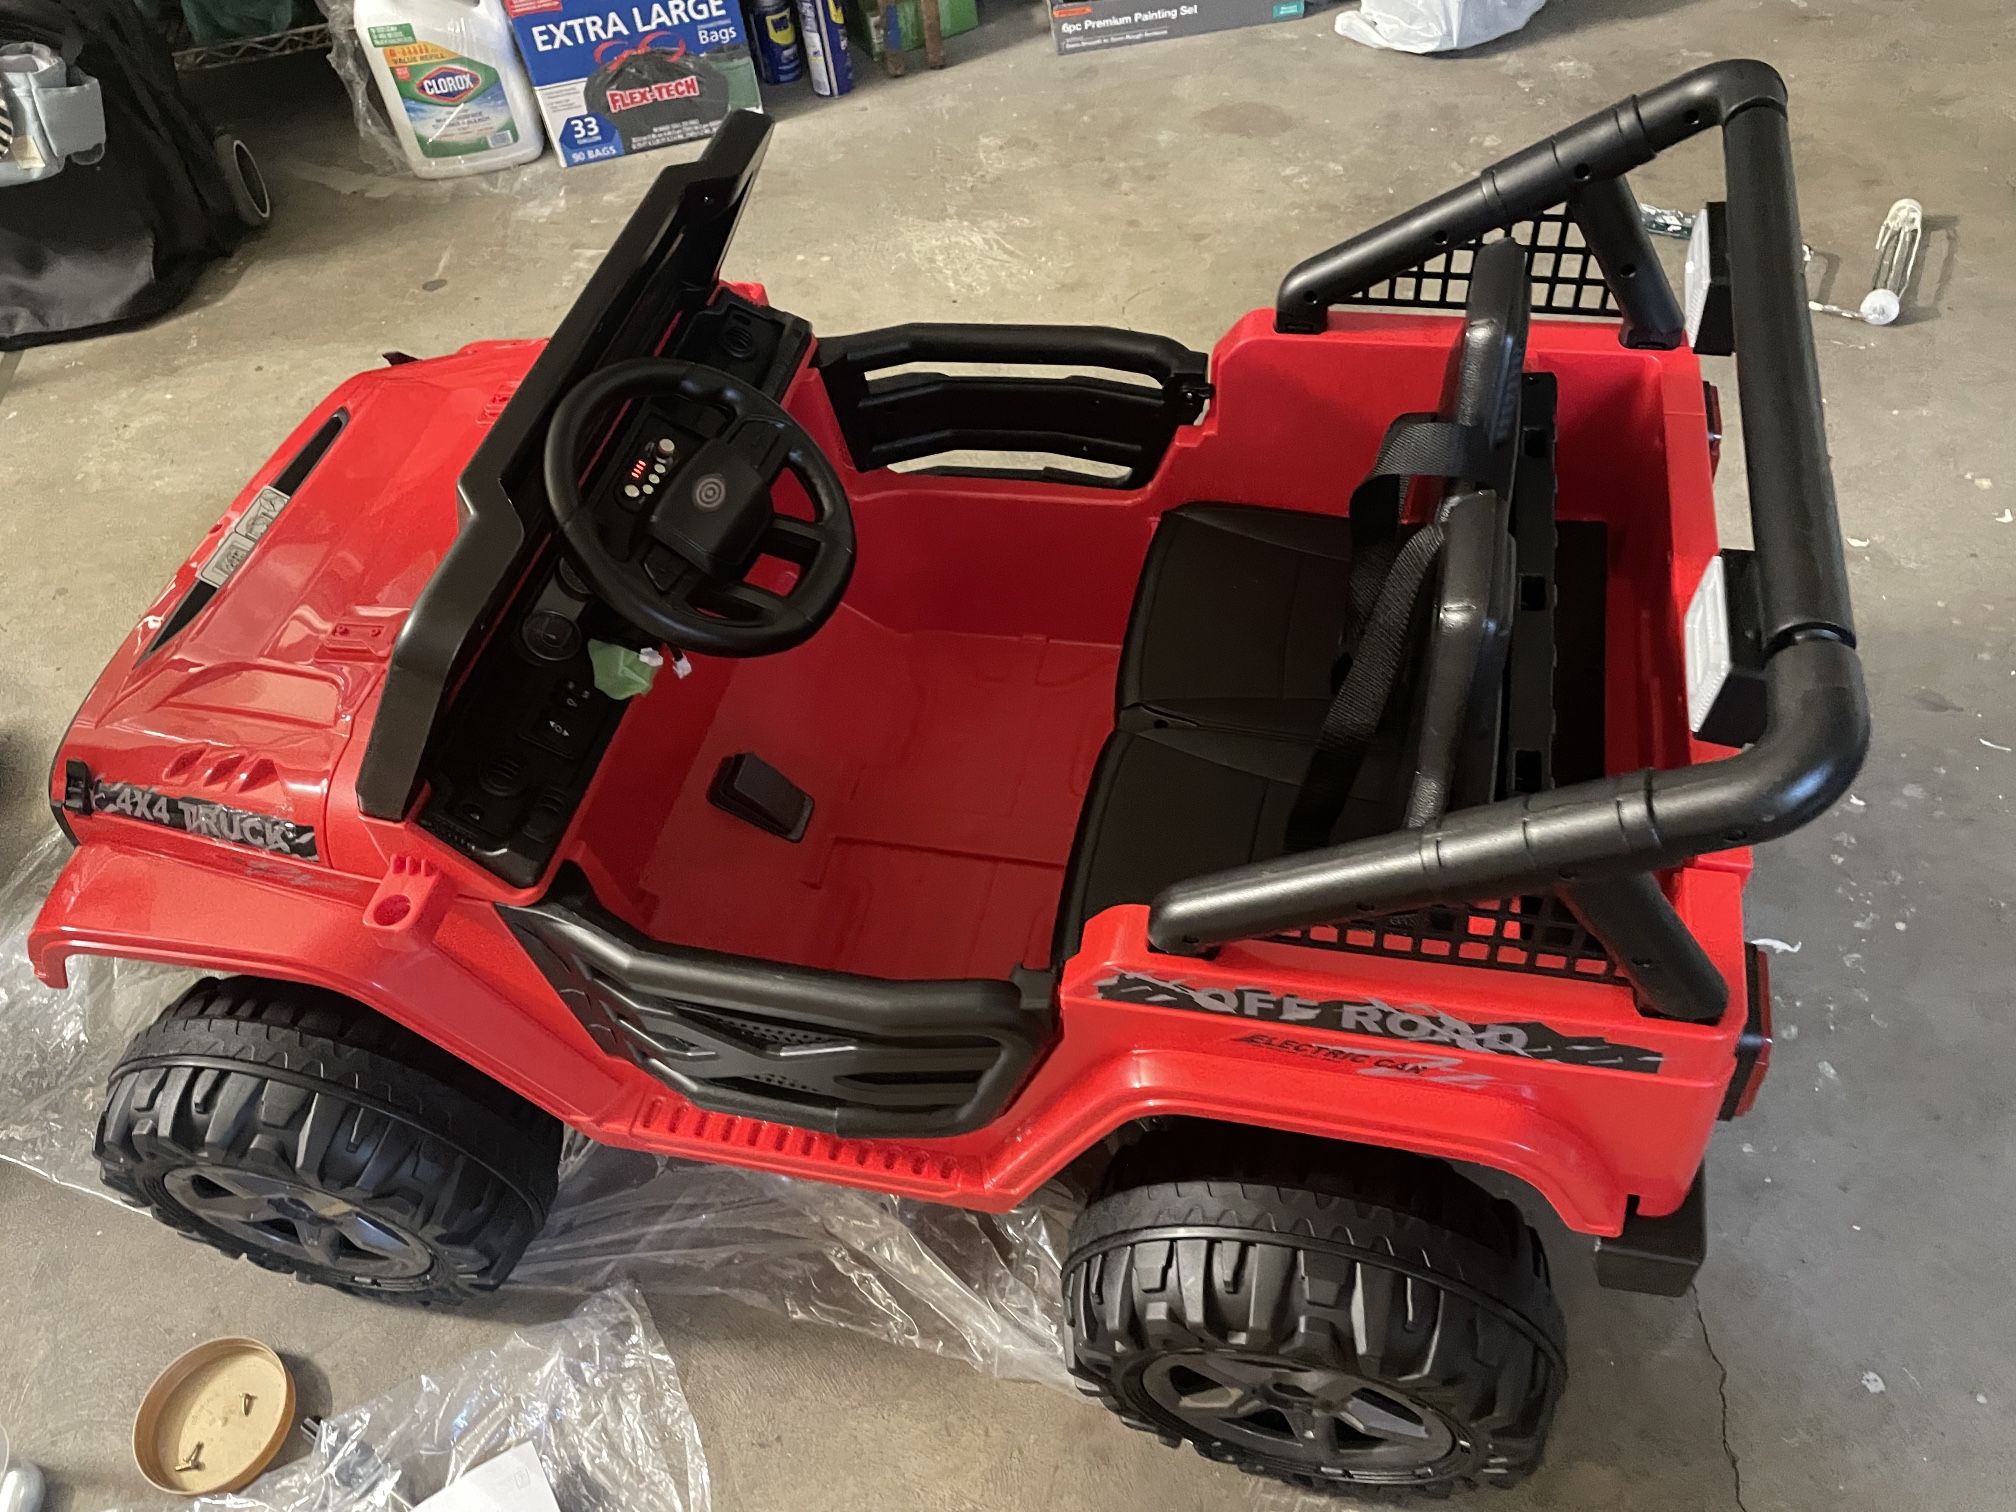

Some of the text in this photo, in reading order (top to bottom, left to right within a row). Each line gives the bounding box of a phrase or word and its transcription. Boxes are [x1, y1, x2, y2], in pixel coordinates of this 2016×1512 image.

[532, 11, 629, 52] EXTRA
[632, 0, 727, 33] LARGE
[1061, 4, 1198, 35] 6pc Premium Painting Set
[697, 26, 738, 45] Bags
[423, 73, 475, 96] CLOROX
[606, 75, 701, 113] FLEX-TECH
[570, 116, 600, 139] 33
[571, 145, 617, 163] 90 BAGS
[178, 800, 292, 853] TRUCK
[1195, 986, 1528, 1052] OFF ROAD
[1245, 1033, 1371, 1064] ELECTRIC
